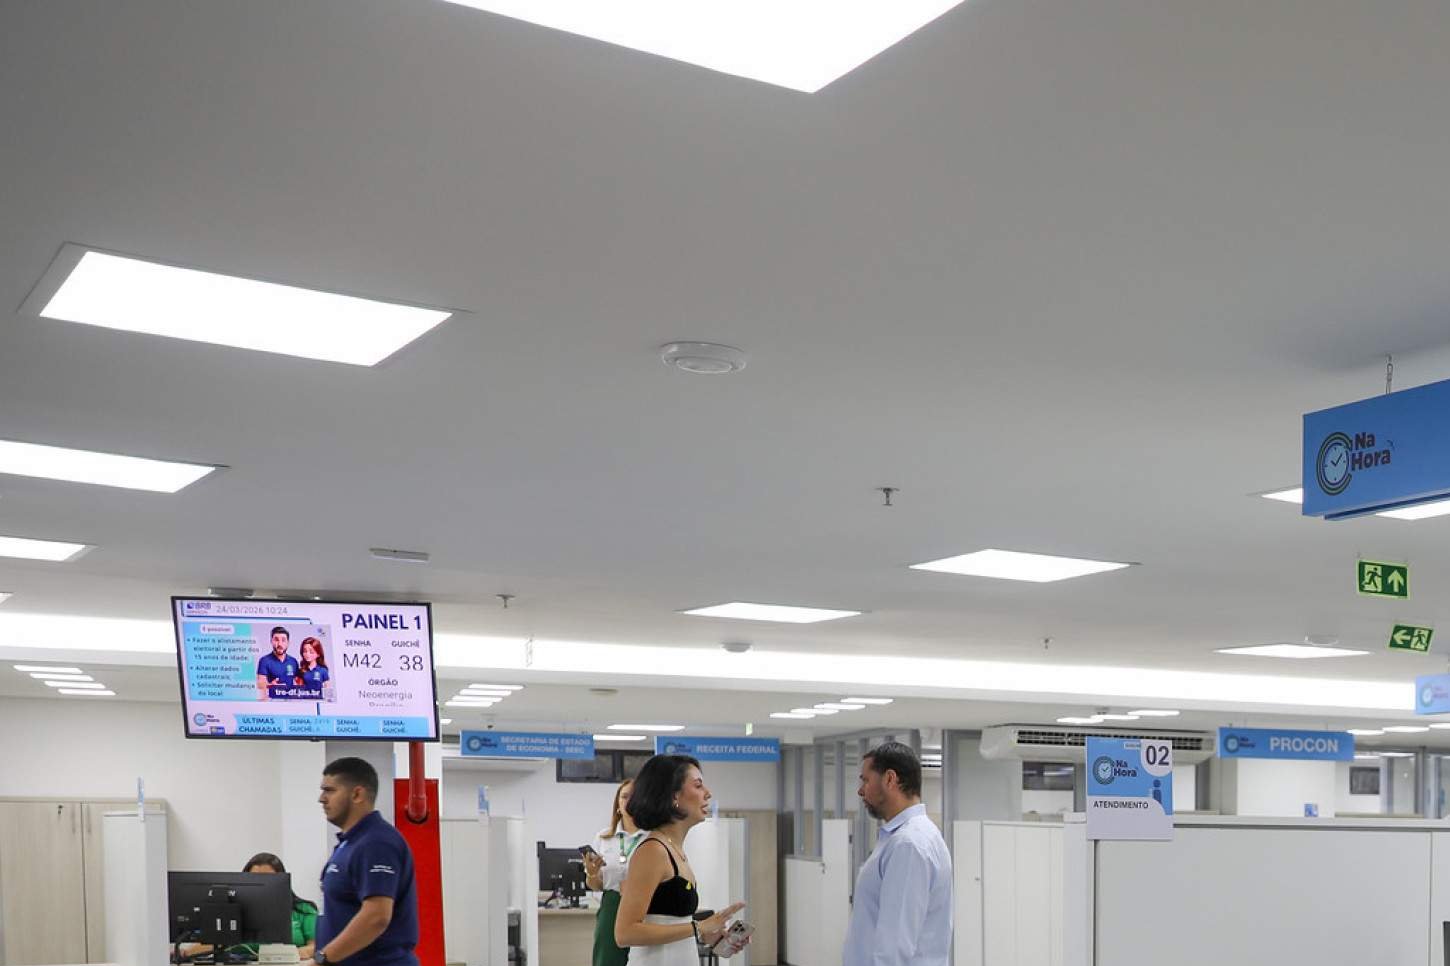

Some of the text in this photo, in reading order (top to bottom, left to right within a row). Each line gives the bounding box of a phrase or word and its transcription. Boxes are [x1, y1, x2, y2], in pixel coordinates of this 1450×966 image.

[1354, 431, 1376, 451] Na
[1351, 448, 1391, 472] Hora
[342, 613, 421, 630] PAINEL 1
[345, 639, 371, 647] SENHA
[343, 653, 382, 669] M42
[400, 654, 424, 672] 38
[358, 690, 413, 701] Neoenergia
[239, 726, 283, 734] CHAMADAS
[696, 744, 735, 754] RECEITA
[737, 745, 776, 754] FEDERAL
[1269, 736, 1339, 753] PROCON
[1146, 745, 1169, 766] 02
[1116, 760, 1128, 768] Na
[1113, 768, 1137, 777] Hora
[1093, 800, 1149, 809] ATENDIMENTO
